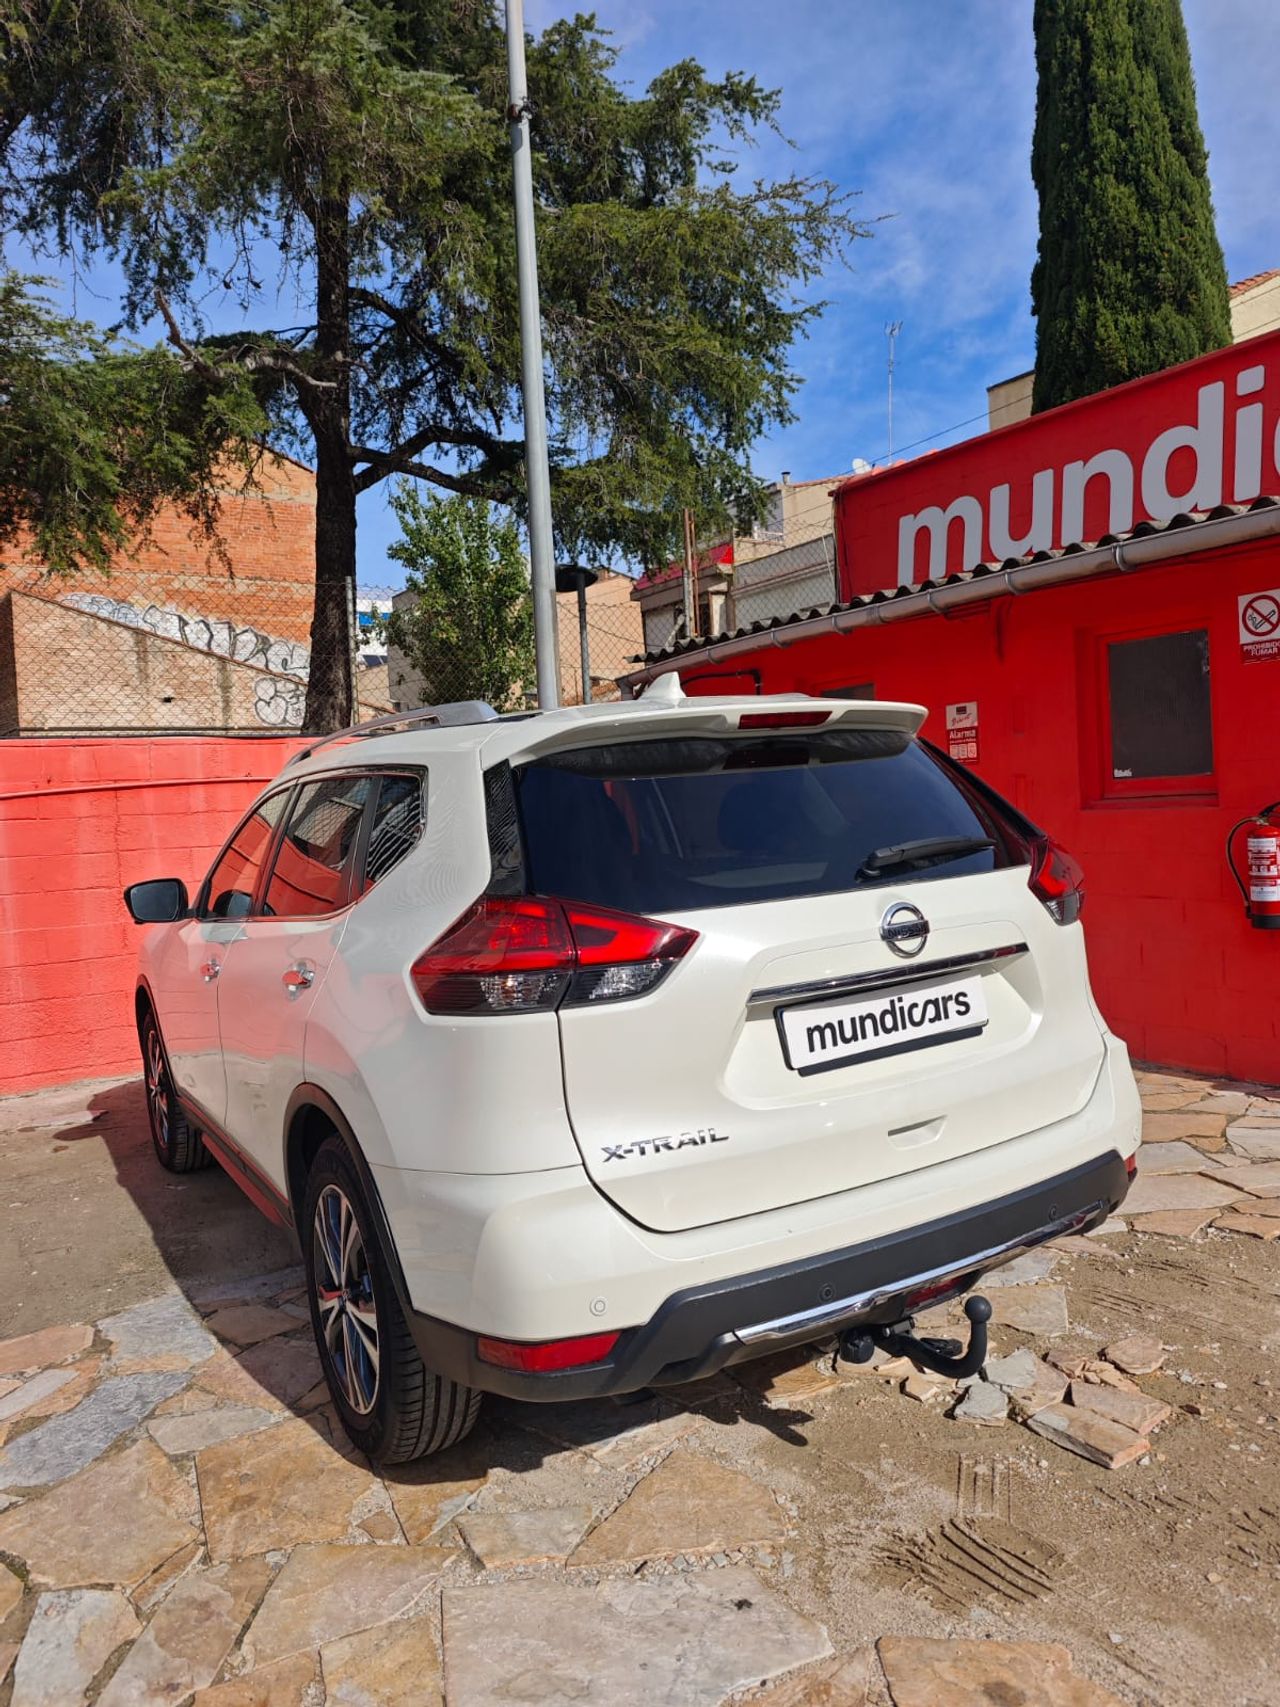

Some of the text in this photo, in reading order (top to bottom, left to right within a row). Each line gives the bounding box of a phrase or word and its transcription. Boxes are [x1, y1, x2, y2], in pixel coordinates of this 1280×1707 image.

[897, 364, 1280, 588] mundi
[1251, 647, 1278, 656] FUMAR
[806, 991, 971, 1053] mundicars
[601, 1128, 729, 1162] X-TRAIL
